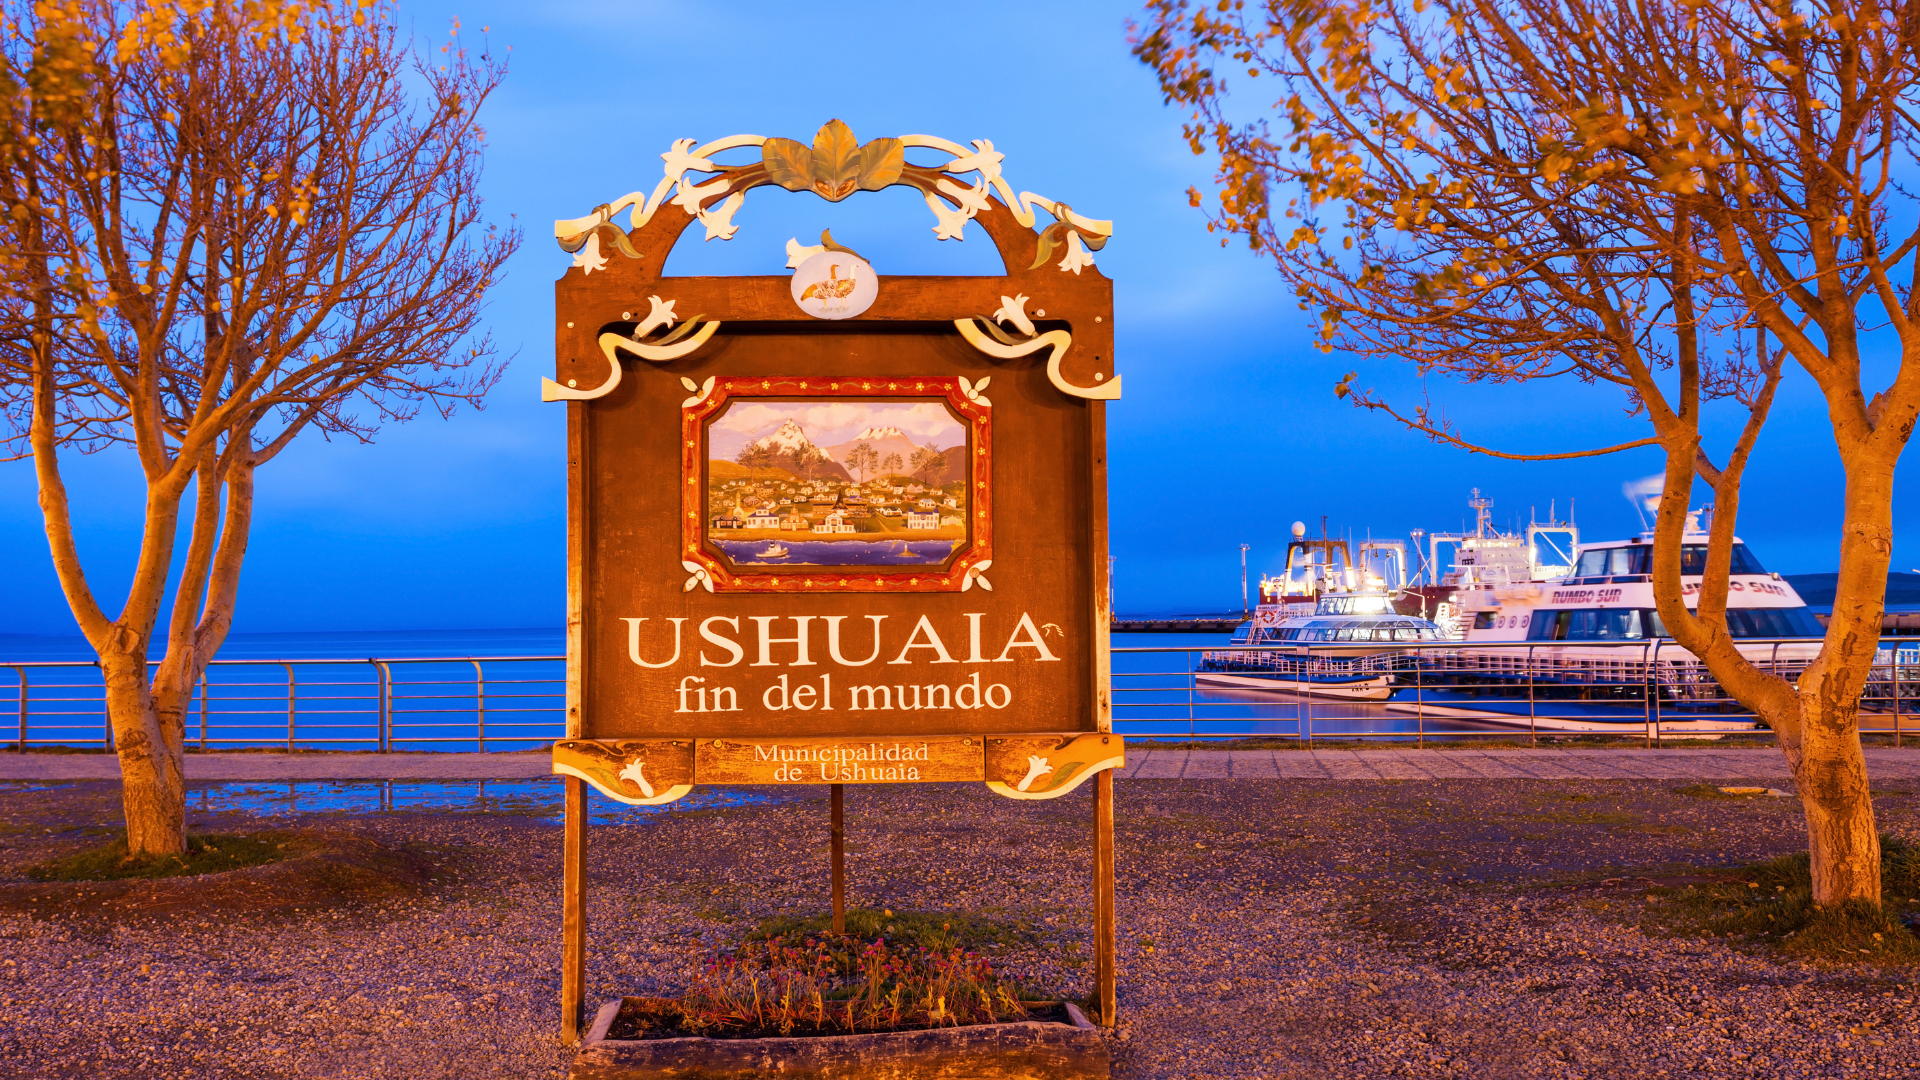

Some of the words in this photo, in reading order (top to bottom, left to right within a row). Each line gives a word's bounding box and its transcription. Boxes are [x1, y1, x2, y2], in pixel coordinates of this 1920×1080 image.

[1551, 590, 1595, 604] RUMBO
[1596, 588, 1622, 603] SUR
[1748, 581, 1788, 597] SUR
[619, 612, 1061, 669] USHUAIA
[674, 676, 743, 713] fin
[762, 673, 833, 711] del
[848, 672, 1012, 710] mundo
[754, 743, 929, 767] Municipalidad
[774, 763, 803, 782] de
[819, 762, 921, 781] Ushuaia
